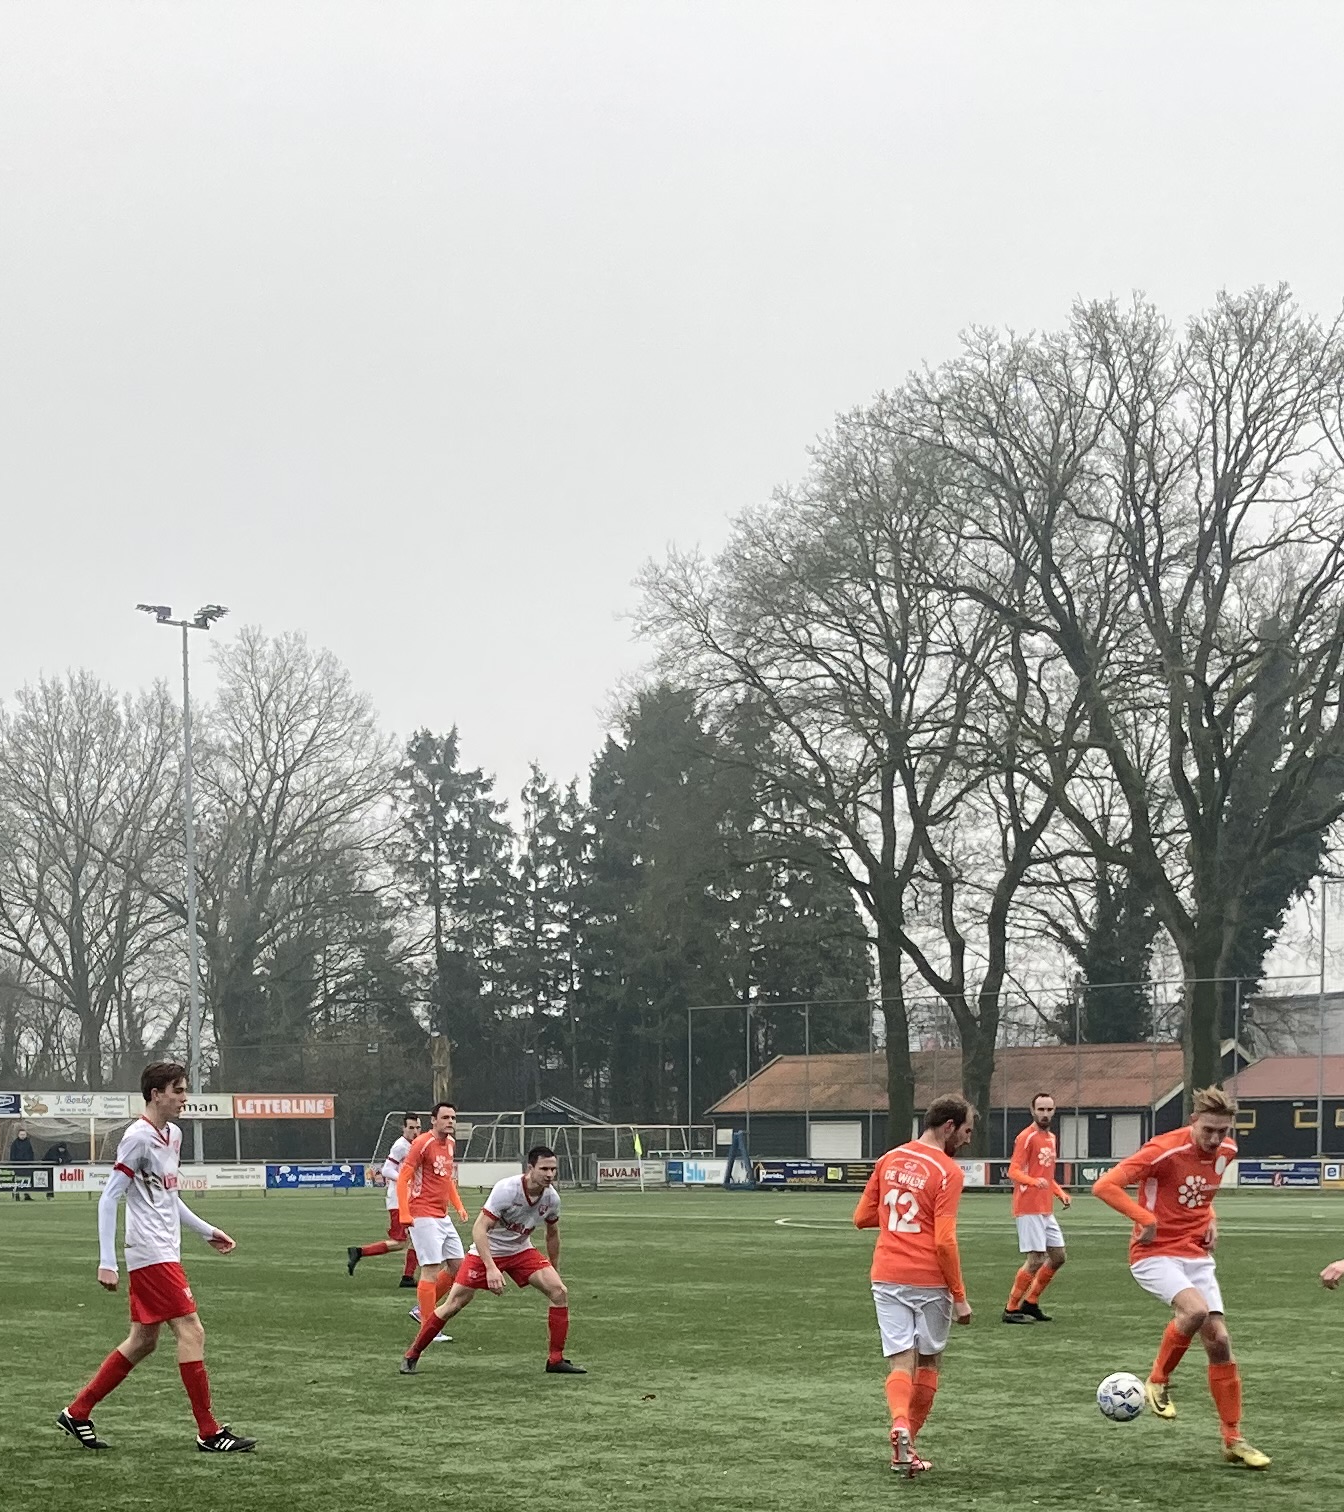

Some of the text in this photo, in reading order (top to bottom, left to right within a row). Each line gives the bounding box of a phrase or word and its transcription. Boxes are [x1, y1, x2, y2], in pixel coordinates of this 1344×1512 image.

[237, 1099, 325, 1114] LETTERLINE
[60, 1169, 84, 1181] dalli
[884, 1169, 897, 1180] DE
[898, 1172, 926, 1190] WILDE
[180, 1180, 208, 1189] WILDE
[884, 1188, 922, 1233] 12
